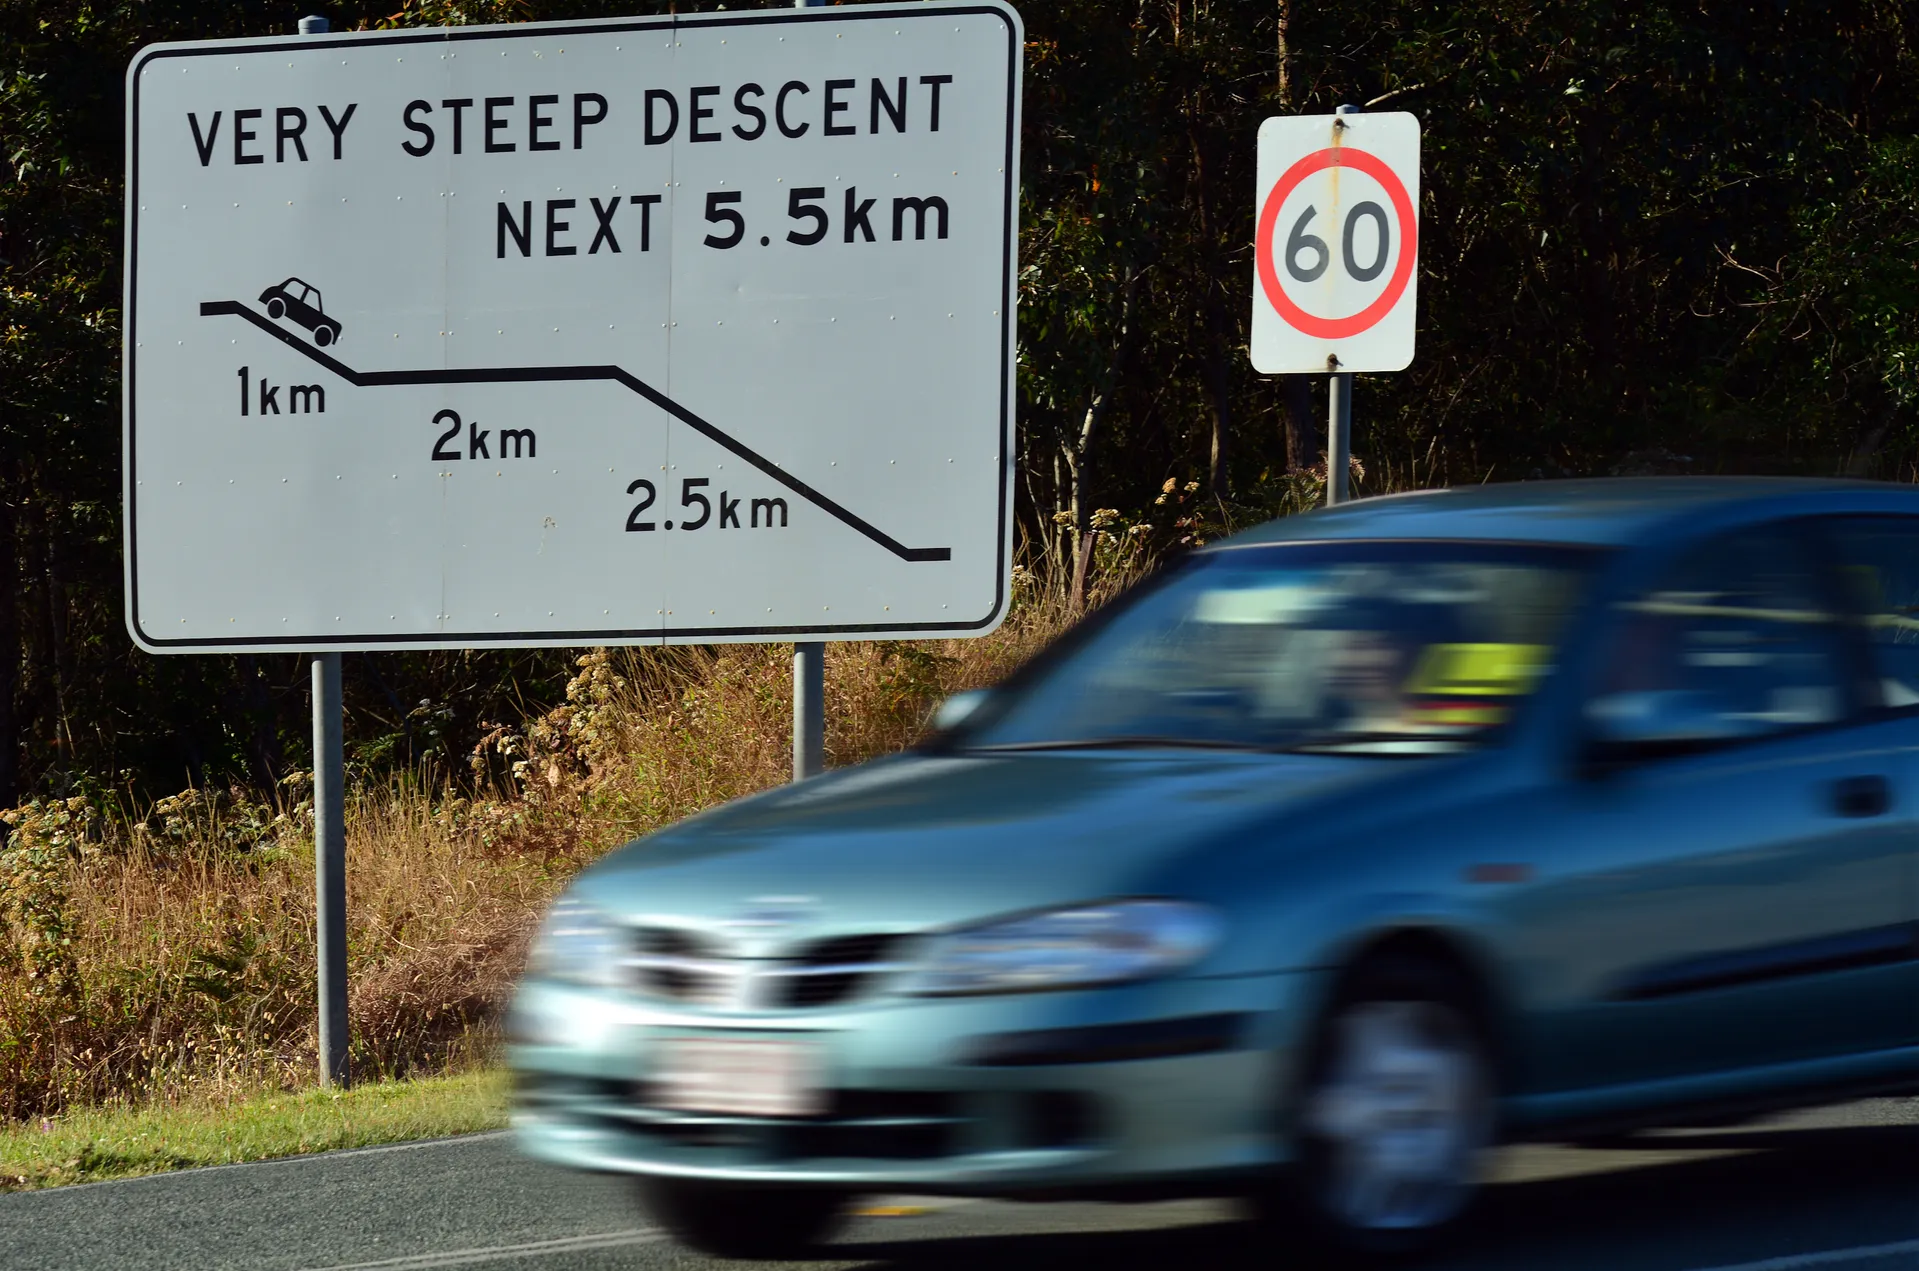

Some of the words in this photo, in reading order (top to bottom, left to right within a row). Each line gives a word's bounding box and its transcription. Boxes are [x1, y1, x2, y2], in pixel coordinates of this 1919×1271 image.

[187, 104, 358, 167] VERY
[402, 92, 609, 157] STEEP
[645, 75, 953, 146] DESCENT
[496, 194, 662, 259] NEXT
[703, 185, 949, 250] 5.5km
[1285, 200, 1390, 283] 60
[237, 365, 325, 417] 1km
[431, 408, 537, 461] 2km
[625, 477, 789, 533] 2.5km
